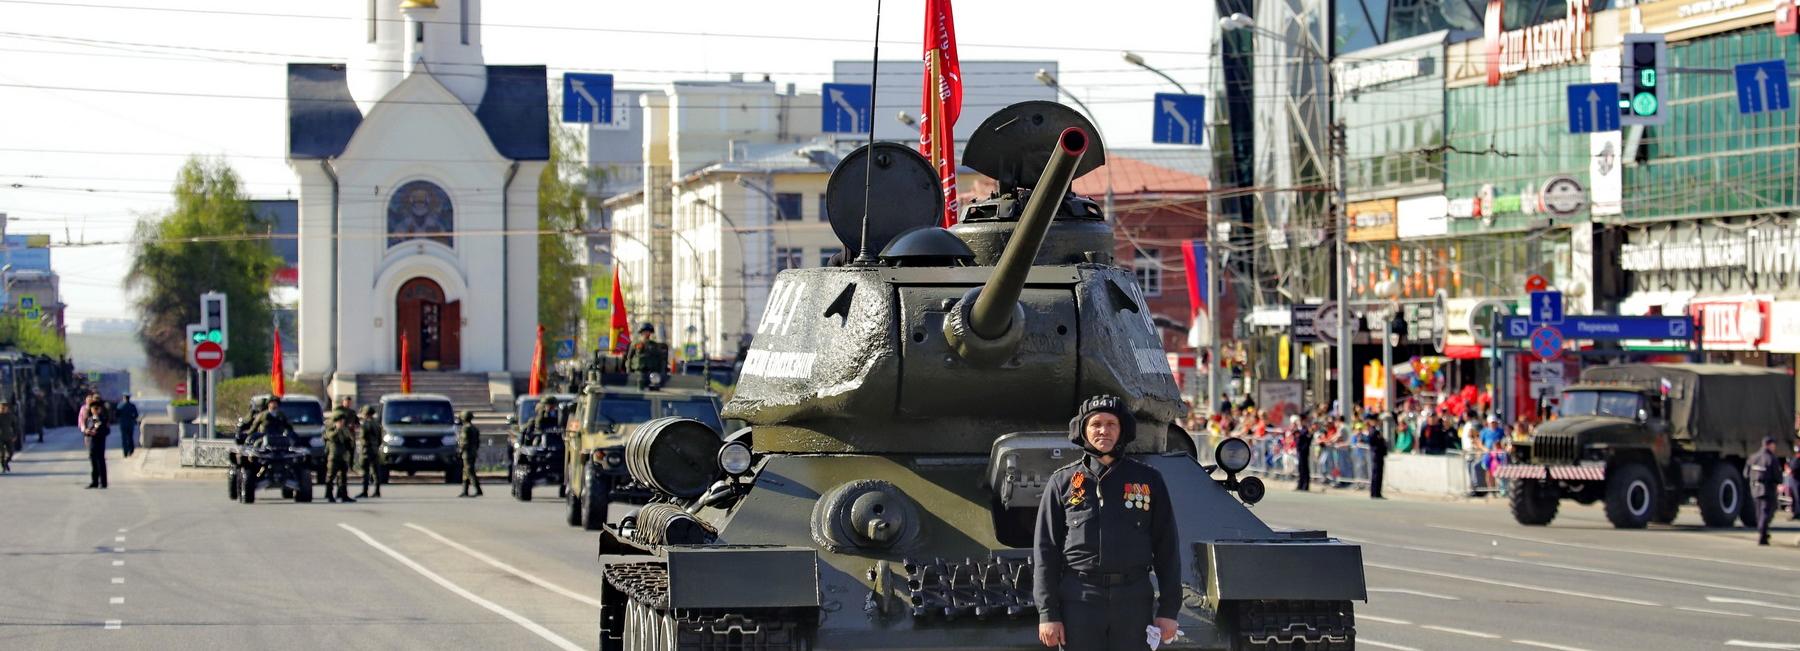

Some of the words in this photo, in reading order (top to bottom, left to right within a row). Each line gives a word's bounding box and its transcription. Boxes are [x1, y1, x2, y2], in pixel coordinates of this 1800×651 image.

[1641, 69, 1655, 86] 10
[758, 280, 806, 335] 041
[1092, 399, 1113, 408] 041
